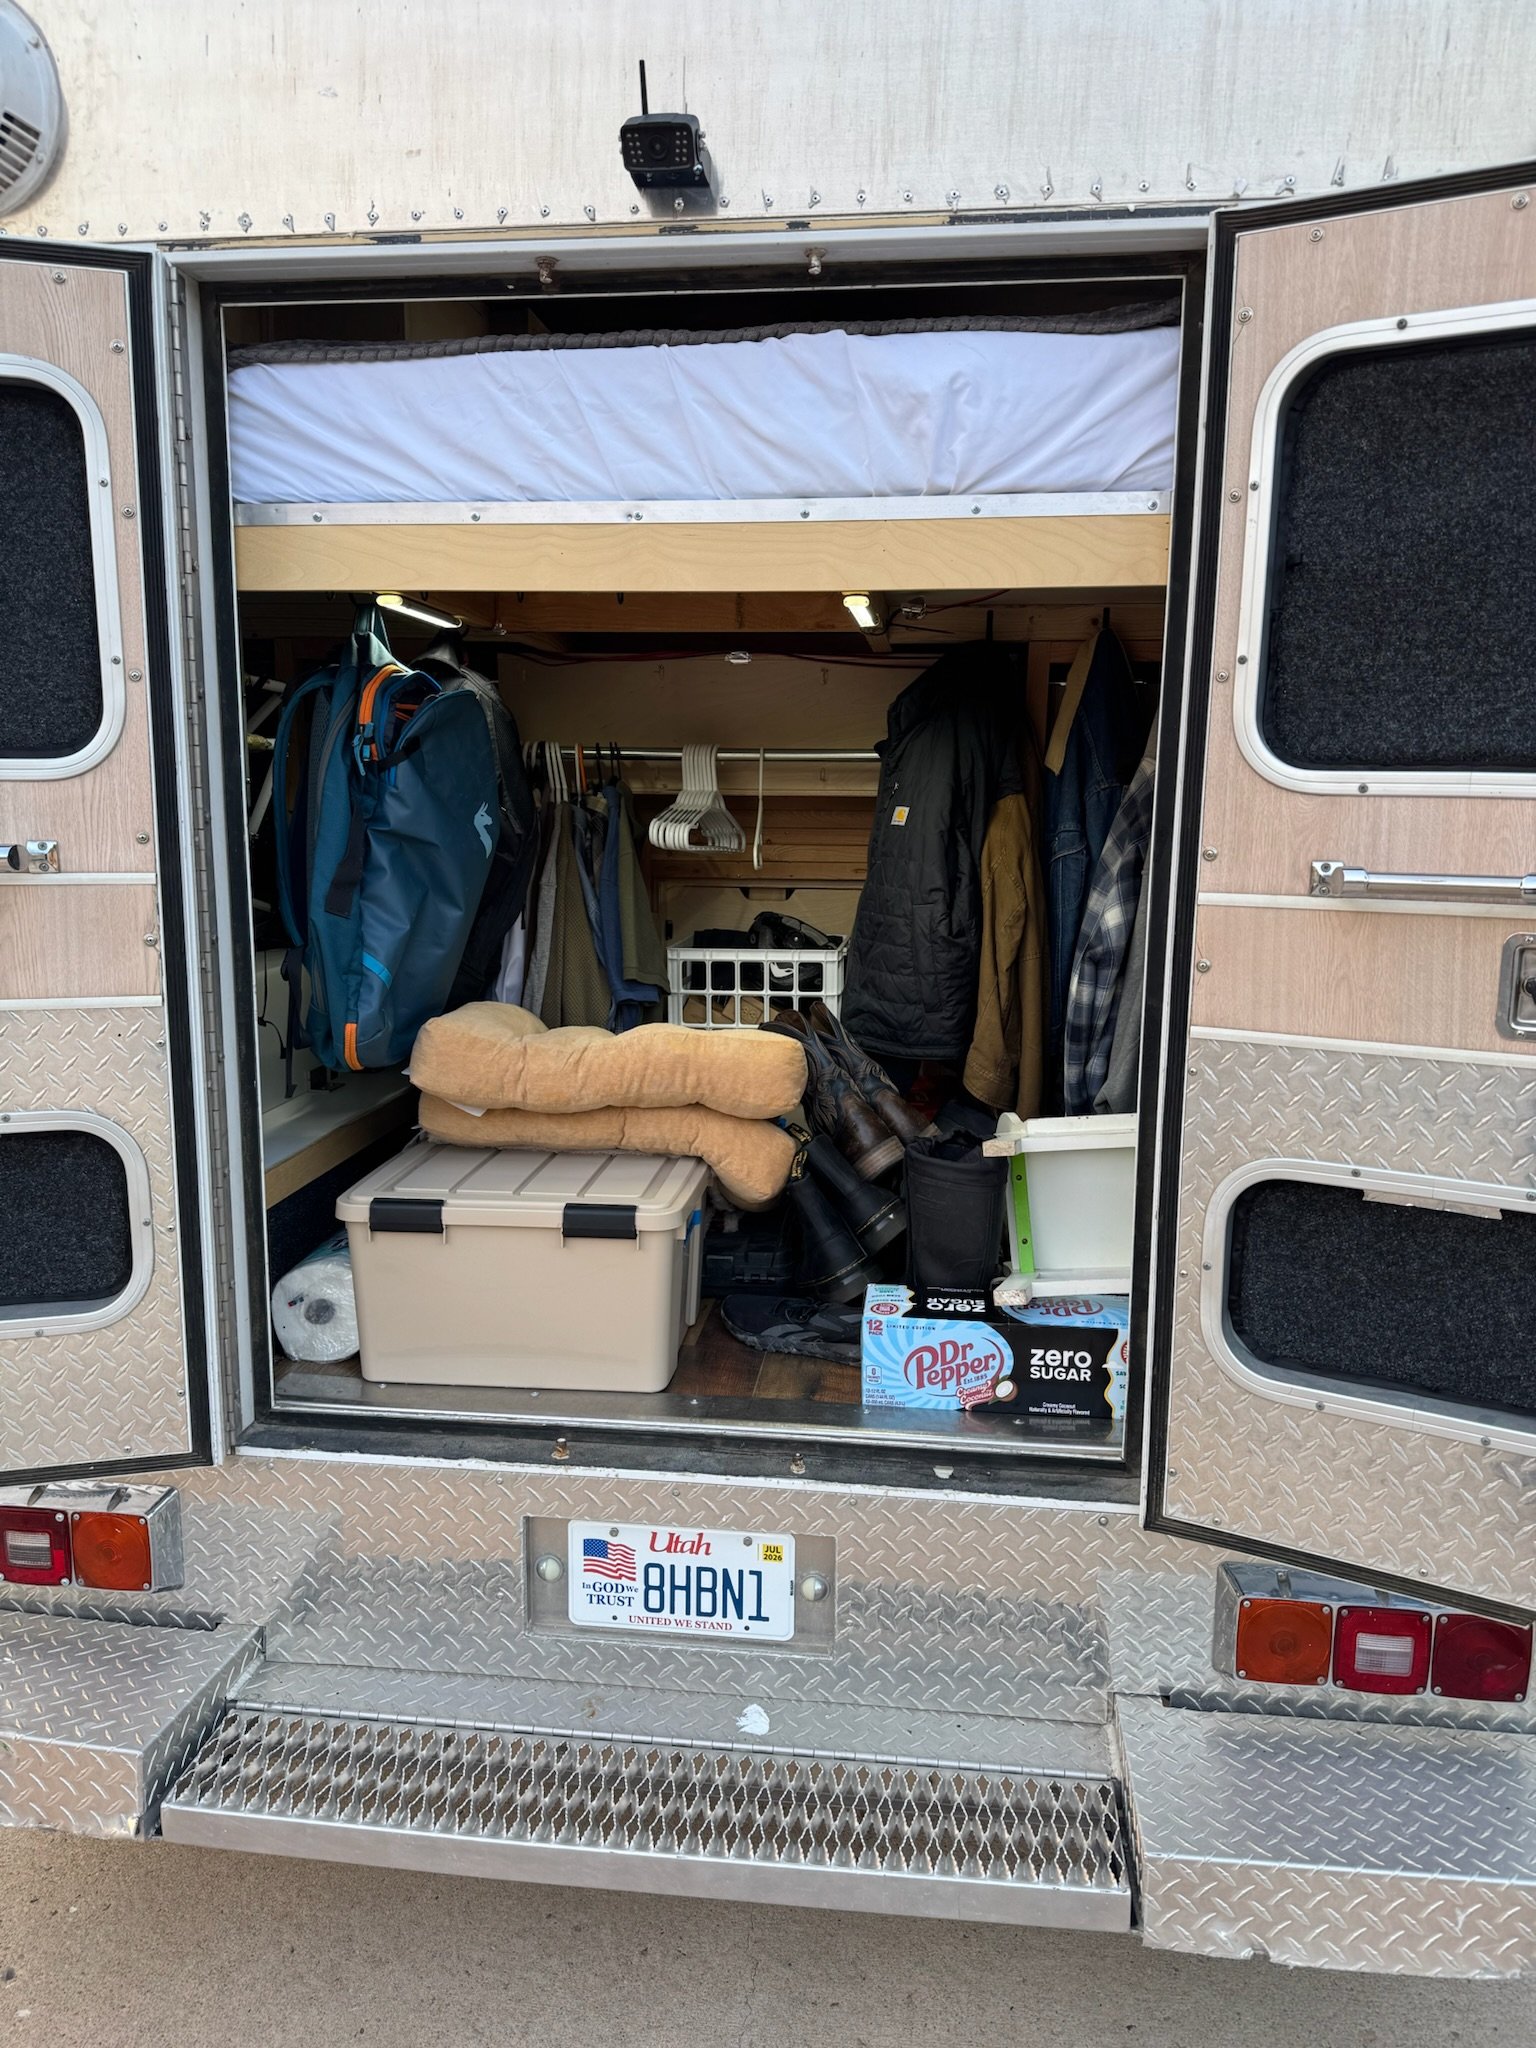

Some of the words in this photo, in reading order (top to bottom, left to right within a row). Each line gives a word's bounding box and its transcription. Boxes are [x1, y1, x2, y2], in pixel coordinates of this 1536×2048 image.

[866, 1319, 883, 1331] 12
[938, 1340, 974, 1367] Dr
[1030, 1348, 1092, 1368] zero
[906, 1345, 997, 1390] Pepper
[1030, 1366, 1092, 1382] SUGAR
[649, 1531, 712, 1556] Utah
[764, 1545, 781, 1554] JUL
[763, 1553, 783, 1561] 2026
[592, 1581, 625, 1594] GOD
[625, 1585, 639, 1593] We
[643, 1562, 770, 1622] 8HBN1
[586, 1593, 635, 1607] TRUST
[628, 1615, 672, 1627] UNITED
[674, 1618, 693, 1628] WE
[694, 1620, 733, 1632] STAND
